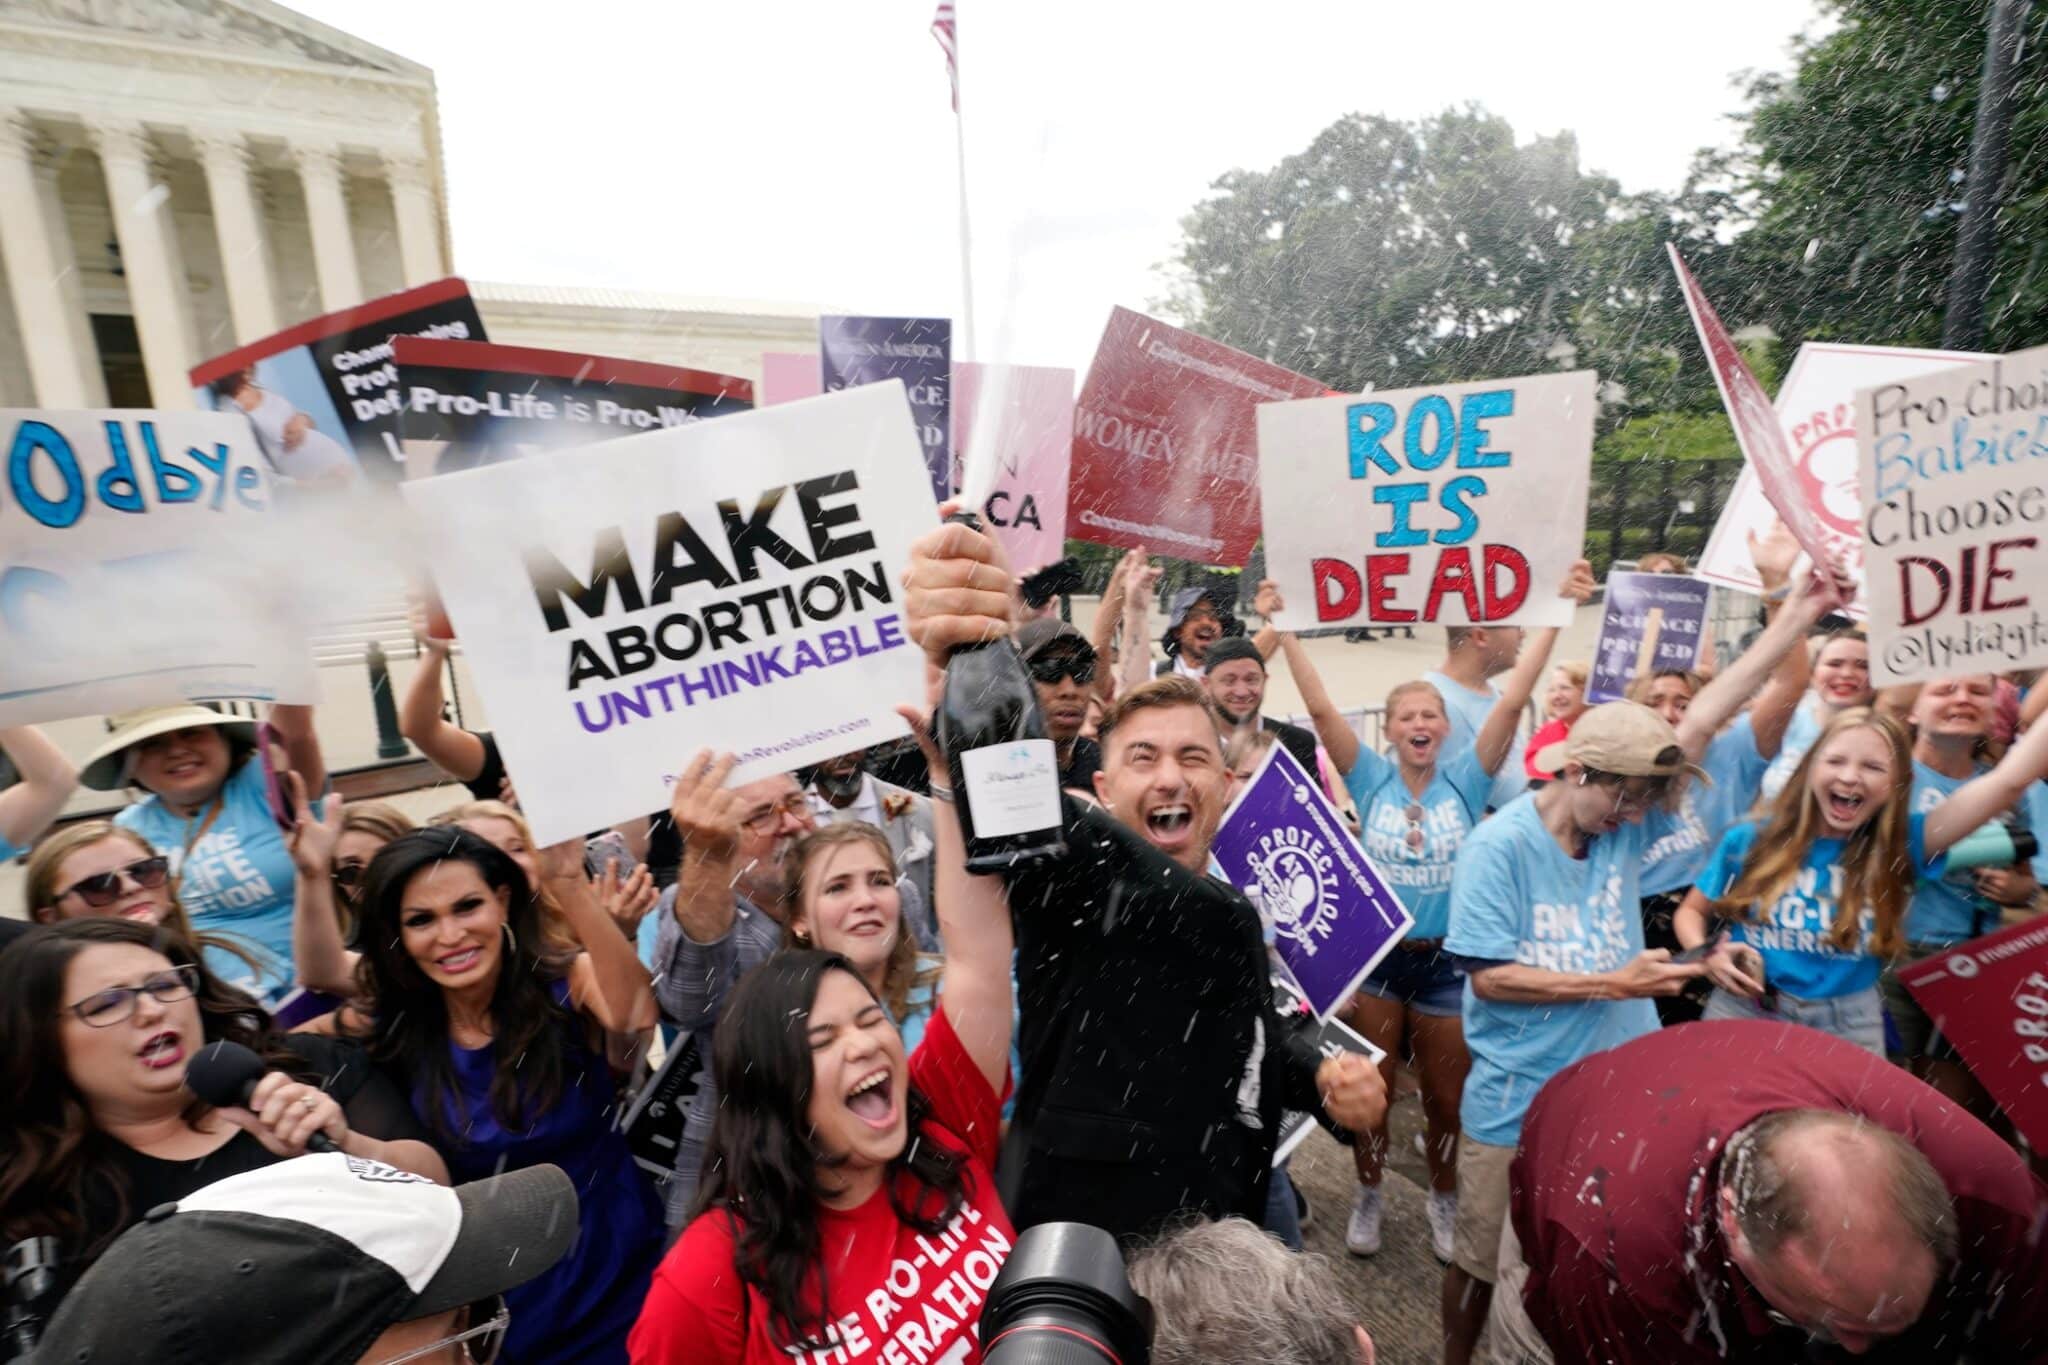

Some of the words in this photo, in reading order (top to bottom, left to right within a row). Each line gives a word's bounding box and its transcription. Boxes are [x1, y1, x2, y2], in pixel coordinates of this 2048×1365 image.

[409, 387, 557, 419] Pro-Life
[563, 396, 592, 423] is
[1076, 407, 1179, 464] WOMEN
[1346, 389, 1513, 479] ROE
[1791, 403, 1856, 449] PRO
[520, 469, 877, 633] MAKE
[1372, 475, 1487, 547] IS
[1867, 486, 2047, 547] Choose
[567, 560, 893, 691] ABORTION
[1311, 544, 1531, 623] DEAD
[1895, 537, 2038, 627] DIE
[573, 613, 906, 733] UNTHINKABLE
[1246, 850, 1319, 957] CONCEPTION
[1259, 825, 1341, 940] PROTECTION
[877, 1224, 1012, 1365] ERATION
